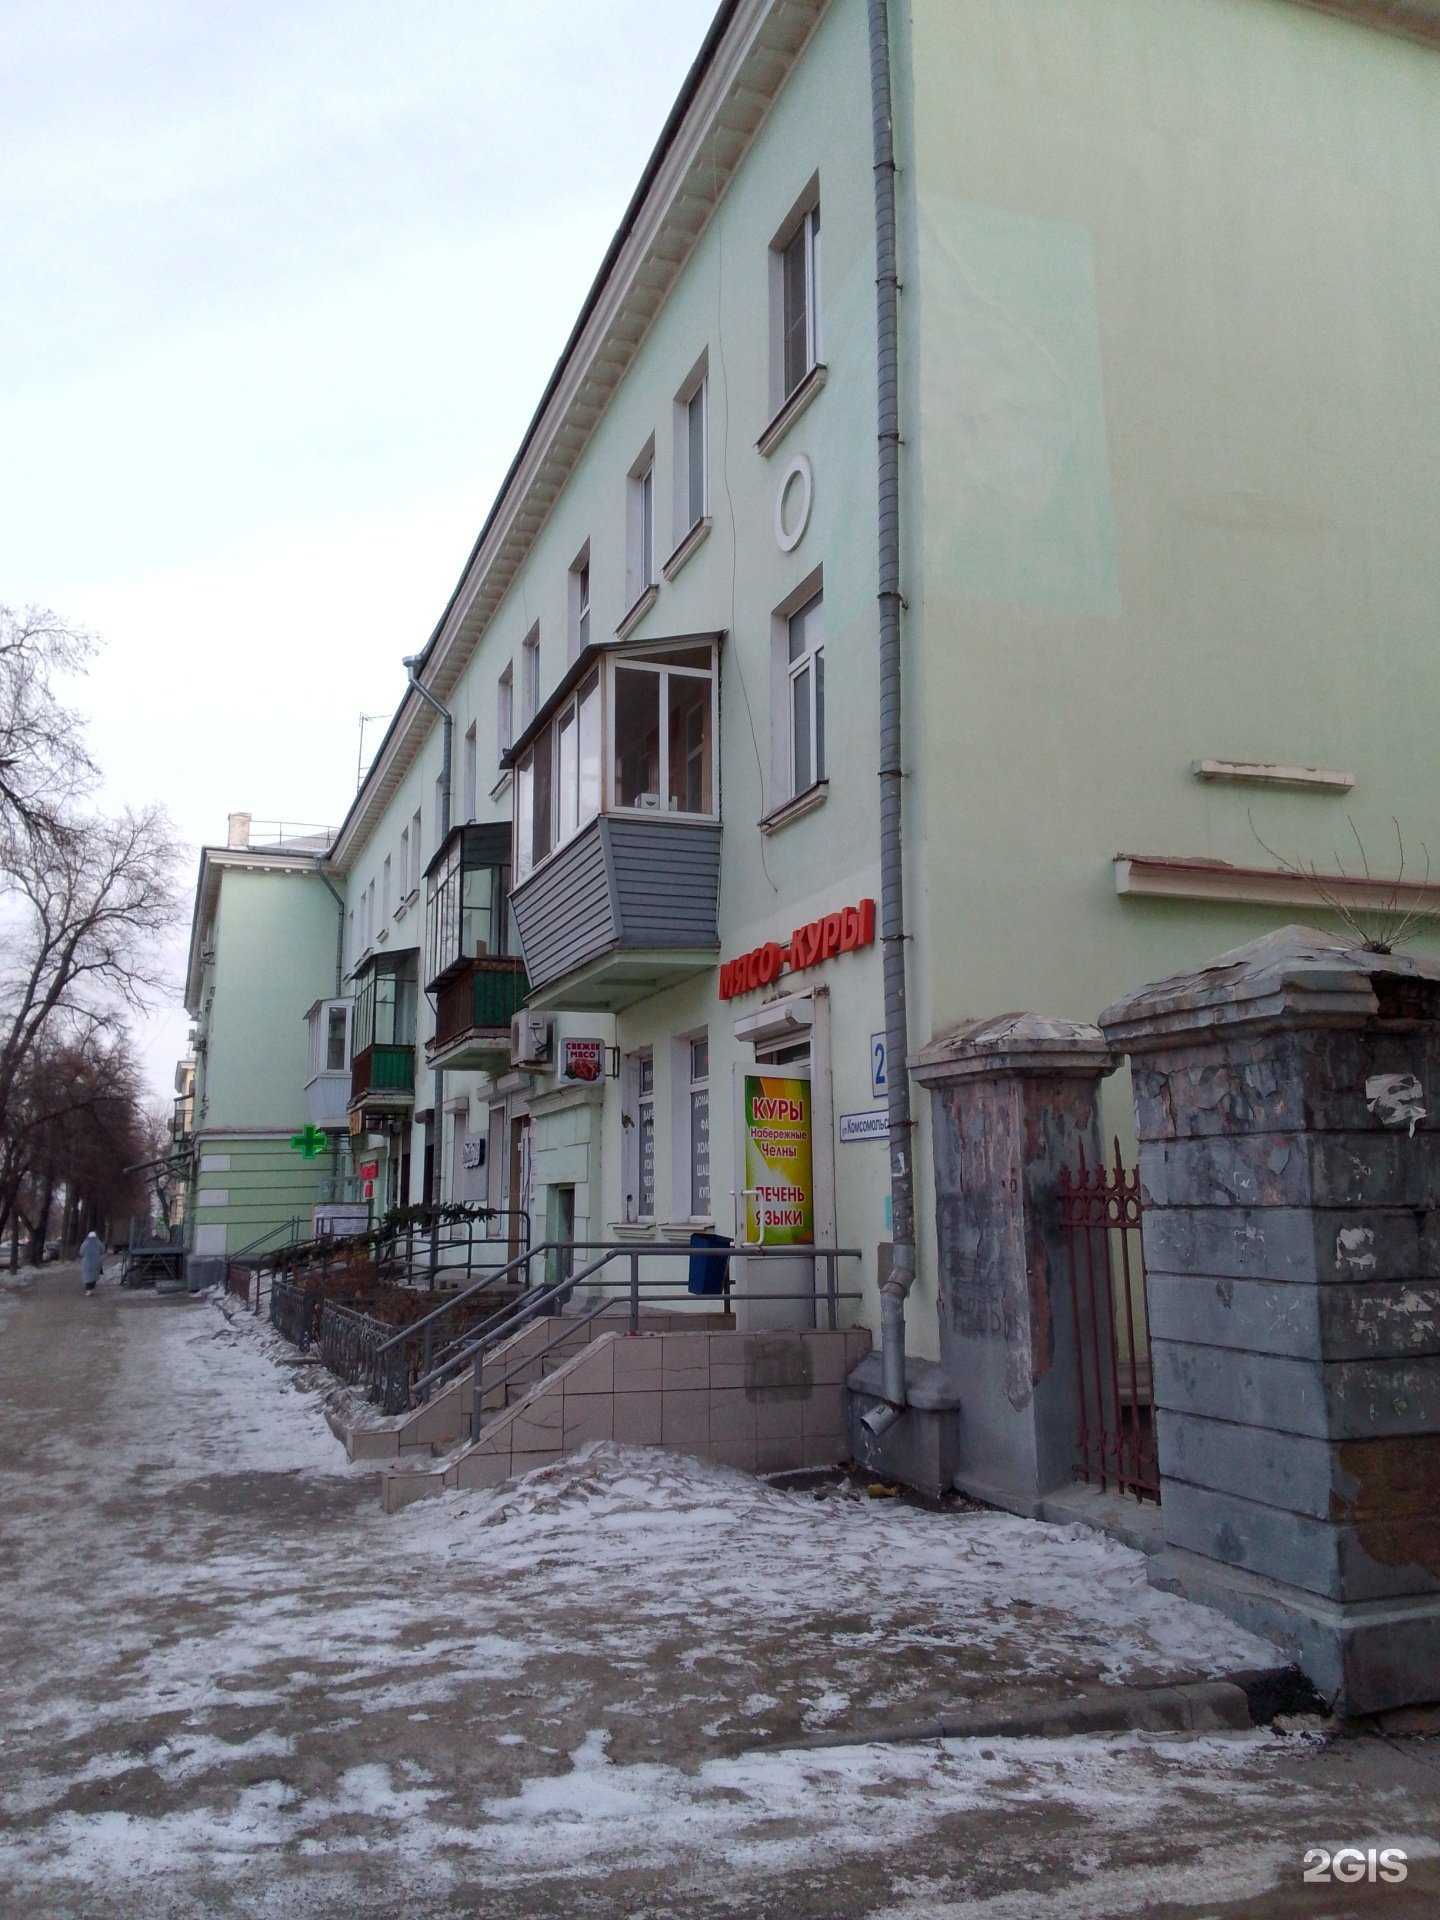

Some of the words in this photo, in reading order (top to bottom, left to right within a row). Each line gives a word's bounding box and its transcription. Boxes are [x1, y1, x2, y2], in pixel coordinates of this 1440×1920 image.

[753, 1098, 804, 1121] КУРЫ
[750, 1127, 808, 1141] Набережные
[761, 1142, 797, 1157] Челны
